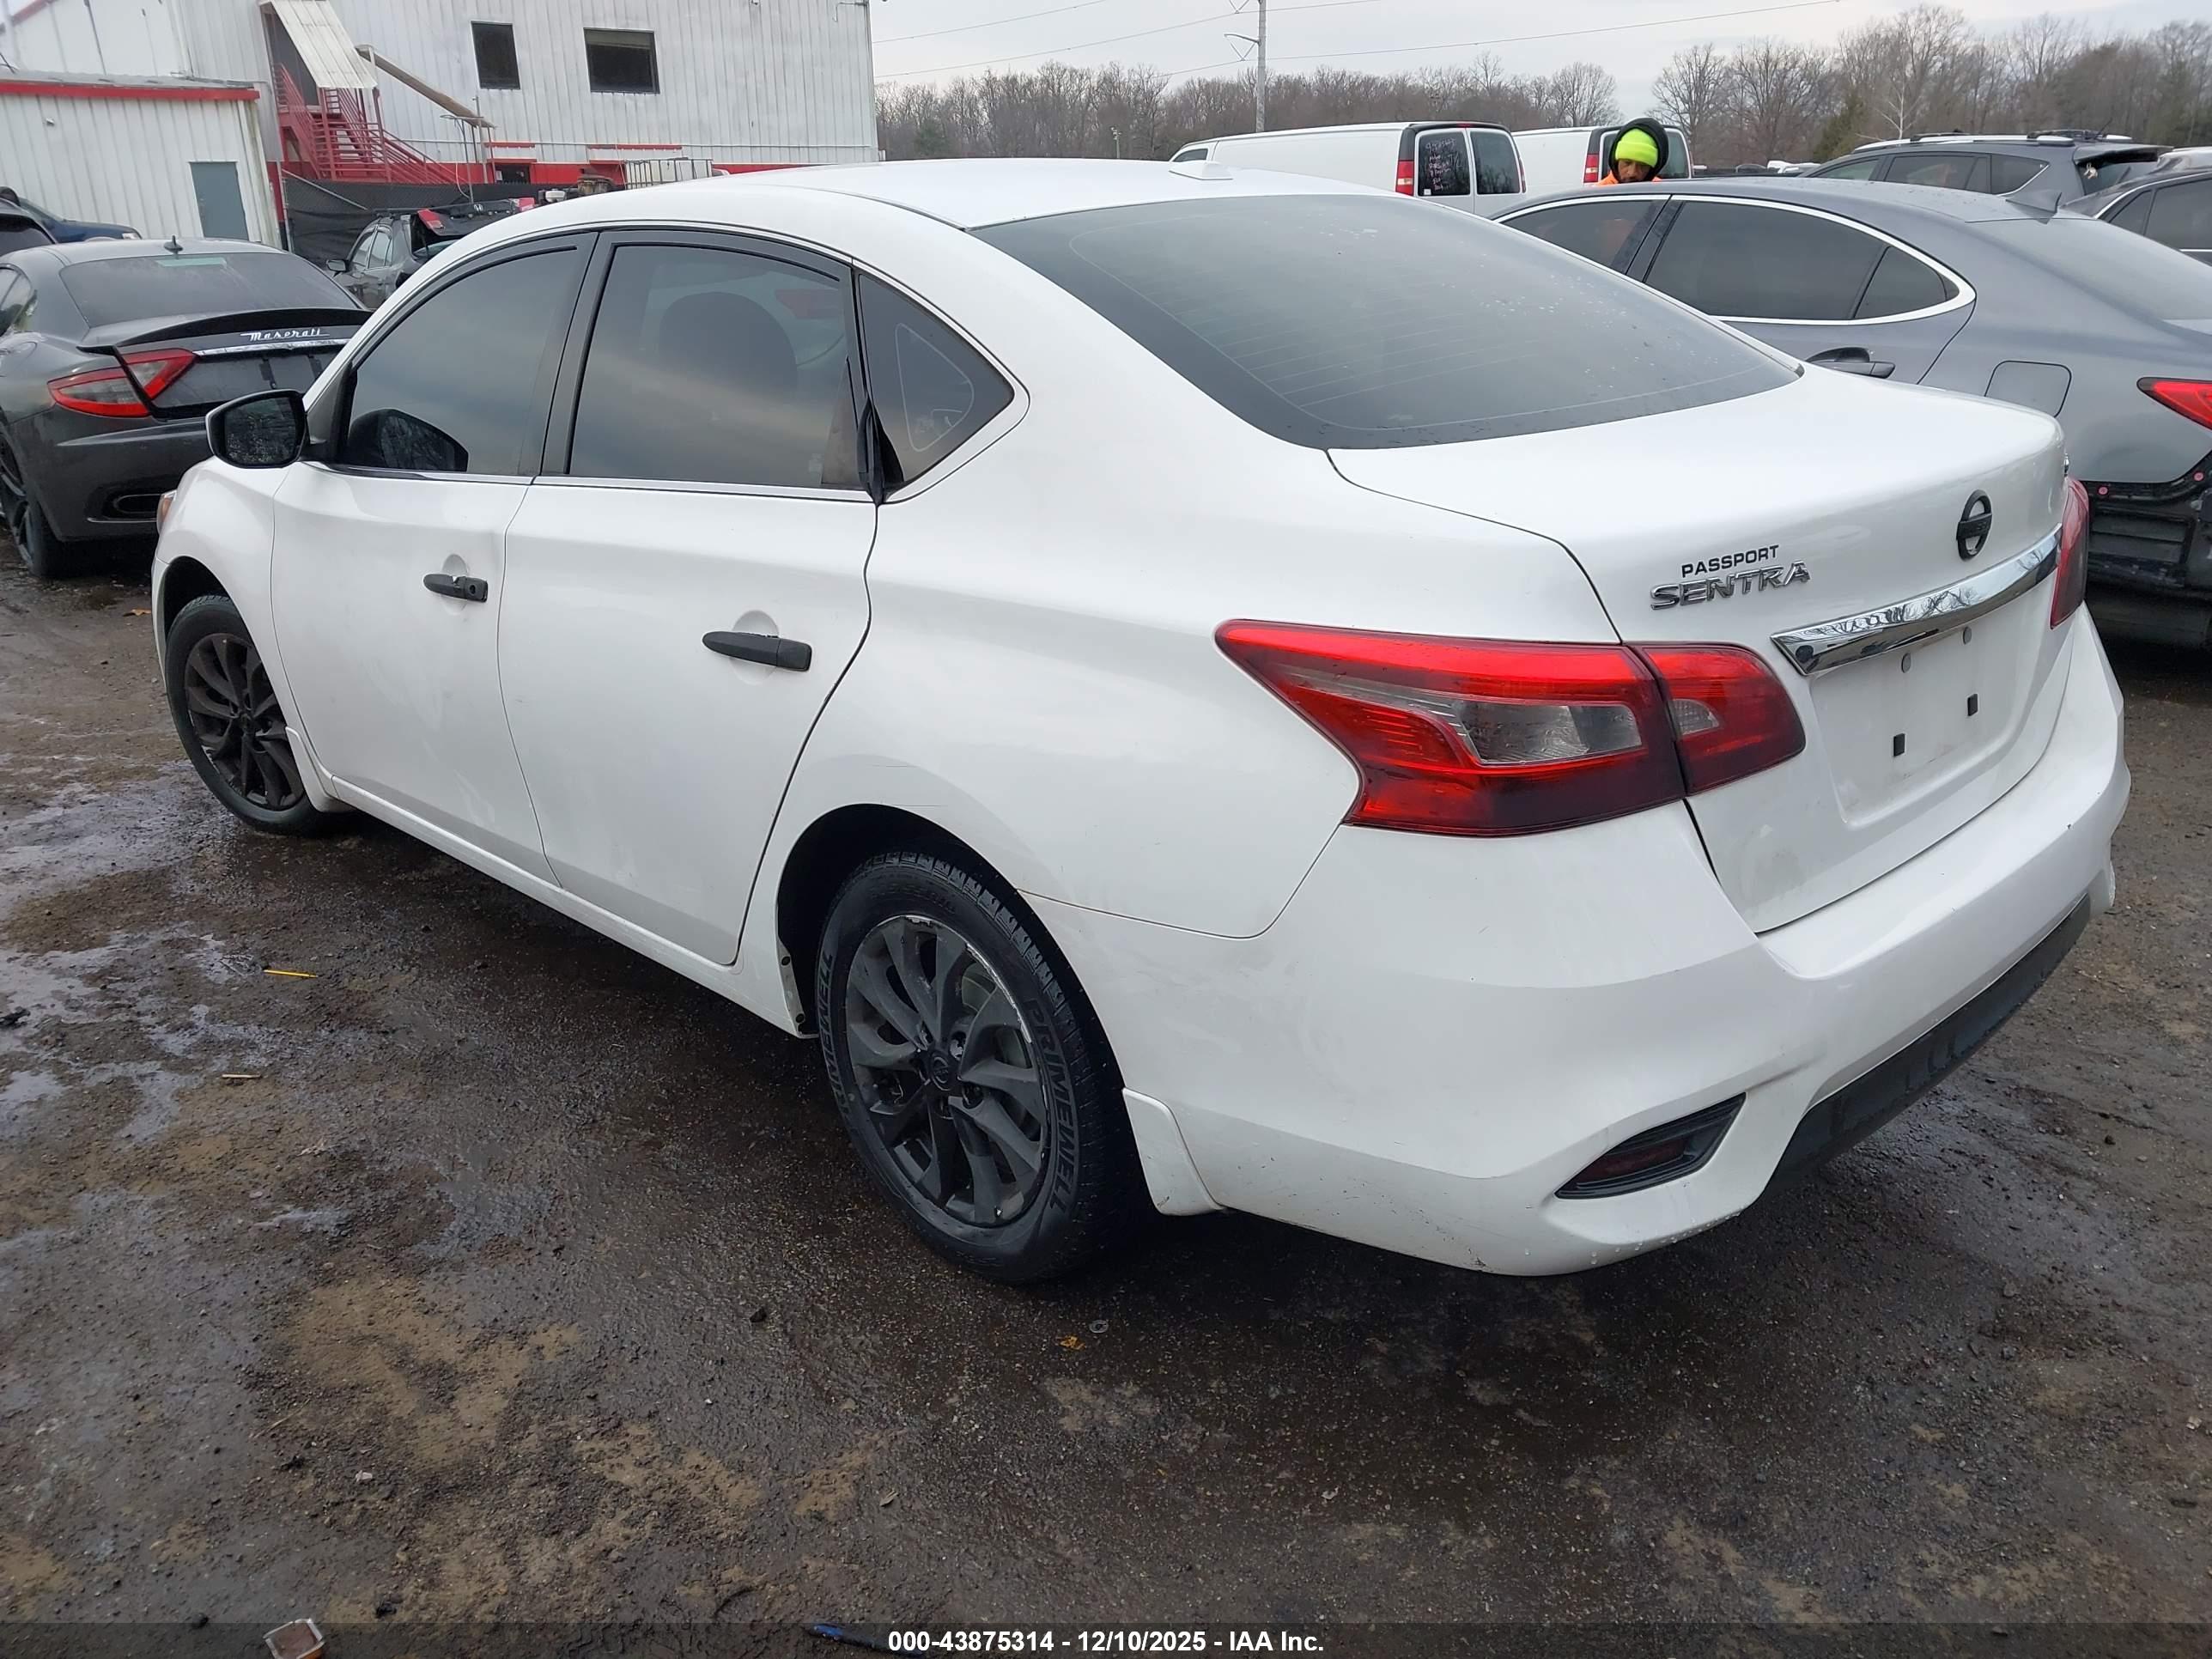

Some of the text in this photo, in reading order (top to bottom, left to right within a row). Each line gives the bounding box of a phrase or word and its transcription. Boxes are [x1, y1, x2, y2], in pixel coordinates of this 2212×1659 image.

[240, 327, 331, 343] Maserati
[1681, 544, 1780, 578] PASSPORT
[1650, 560, 1810, 611] SENTRA
[1023, 999, 1077, 1212] PRIMEWELL
